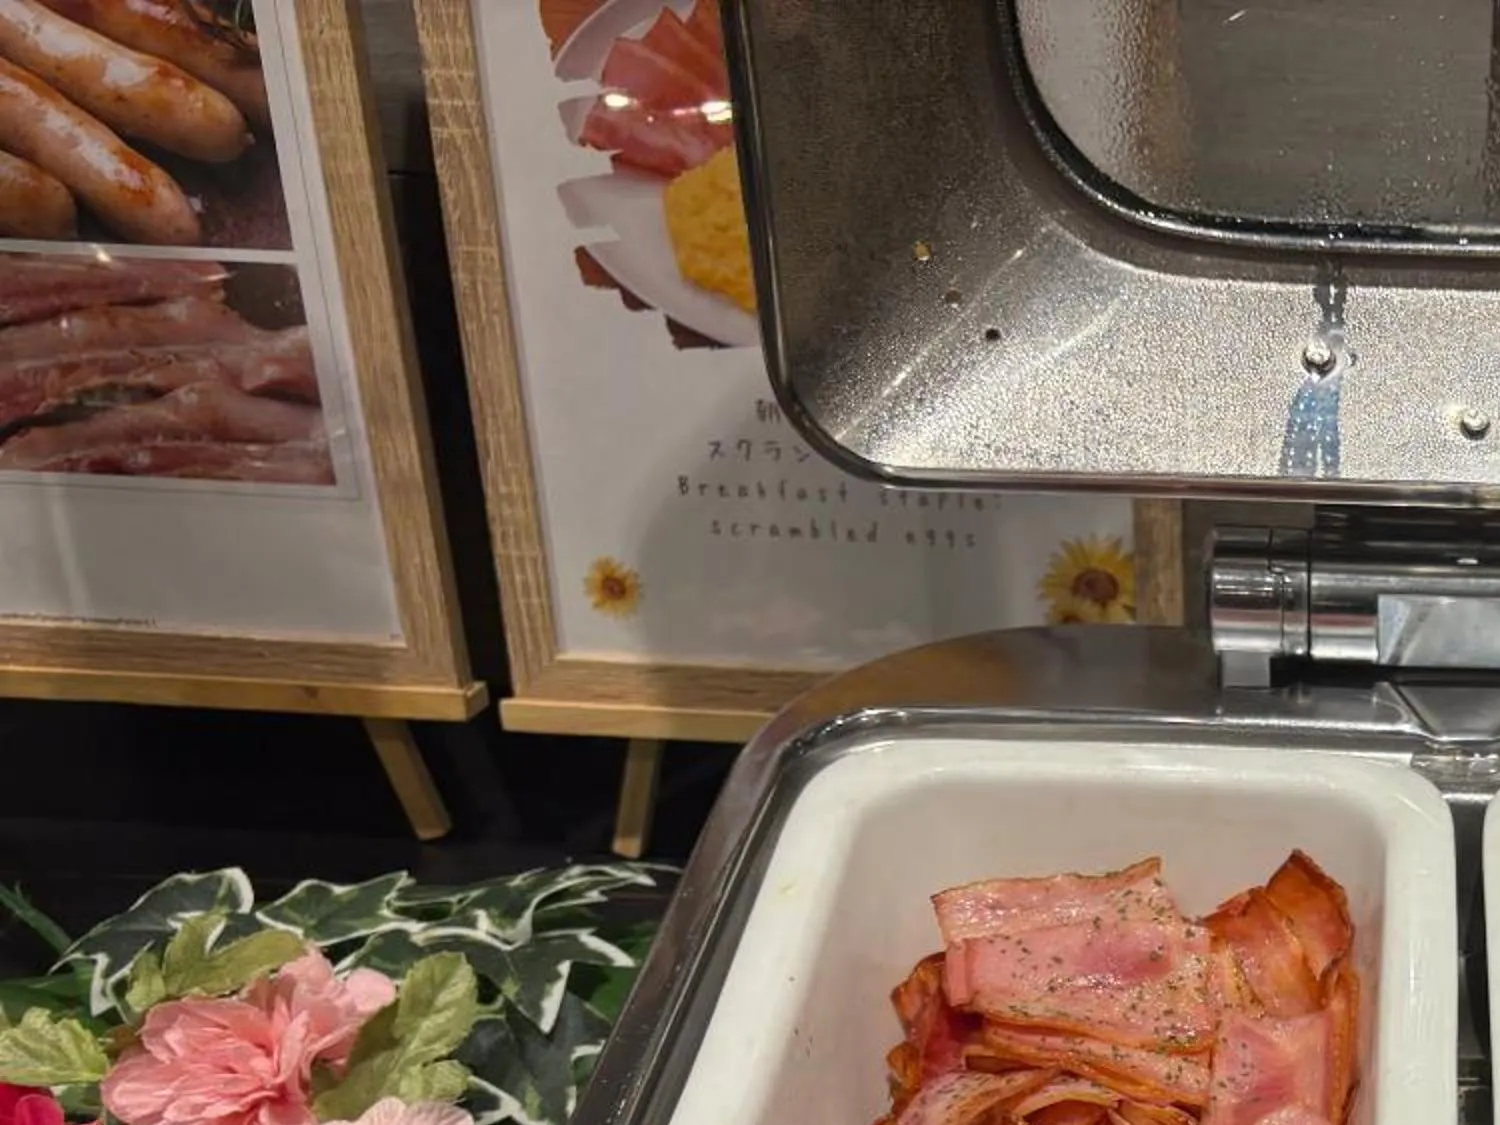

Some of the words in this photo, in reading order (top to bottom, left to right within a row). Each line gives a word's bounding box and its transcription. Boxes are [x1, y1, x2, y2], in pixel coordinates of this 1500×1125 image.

[677, 475, 848, 504] Breakfast
[711, 516, 878, 543] scrambled
[904, 528, 975, 549] eggs
